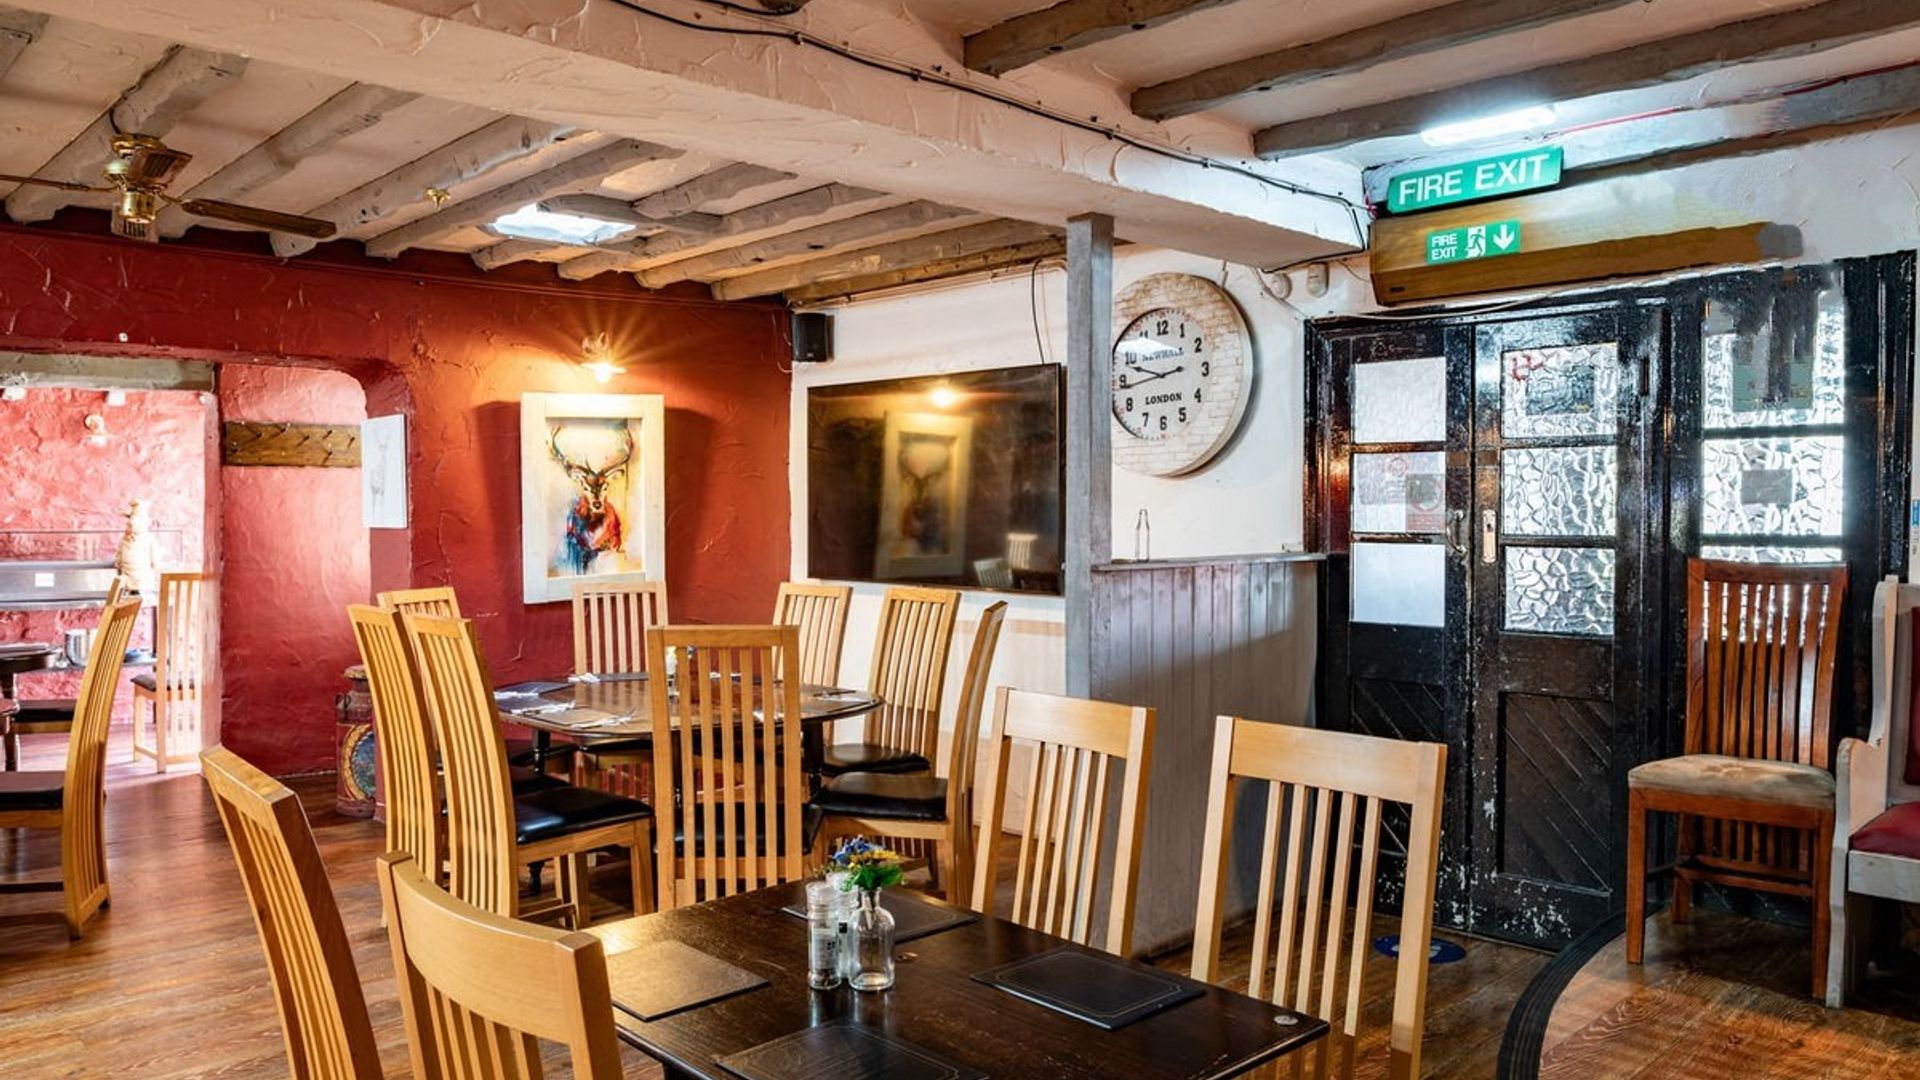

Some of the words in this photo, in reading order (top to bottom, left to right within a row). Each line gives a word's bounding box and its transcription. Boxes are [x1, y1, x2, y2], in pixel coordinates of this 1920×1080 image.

[1399, 169, 1463, 205] FIRE
[1474, 153, 1550, 191] EXIT
[1431, 232, 1458, 248] FIRE
[1431, 246, 1458, 261] EXIT
[1156, 320, 1169, 336] 12
[1180, 322, 1185, 338] 1
[1194, 337, 1202, 353] 2
[1125, 351, 1137, 365] 10
[1201, 361, 1209, 377] 3
[1119, 374, 1127, 389] 9
[1145, 392, 1182, 406] LONDON
[1194, 387, 1202, 403] 4
[1126, 397, 1133, 412] 8
[1142, 411, 1149, 427] 7
[1178, 406, 1187, 422] 5
[1160, 415, 1167, 431] 6
